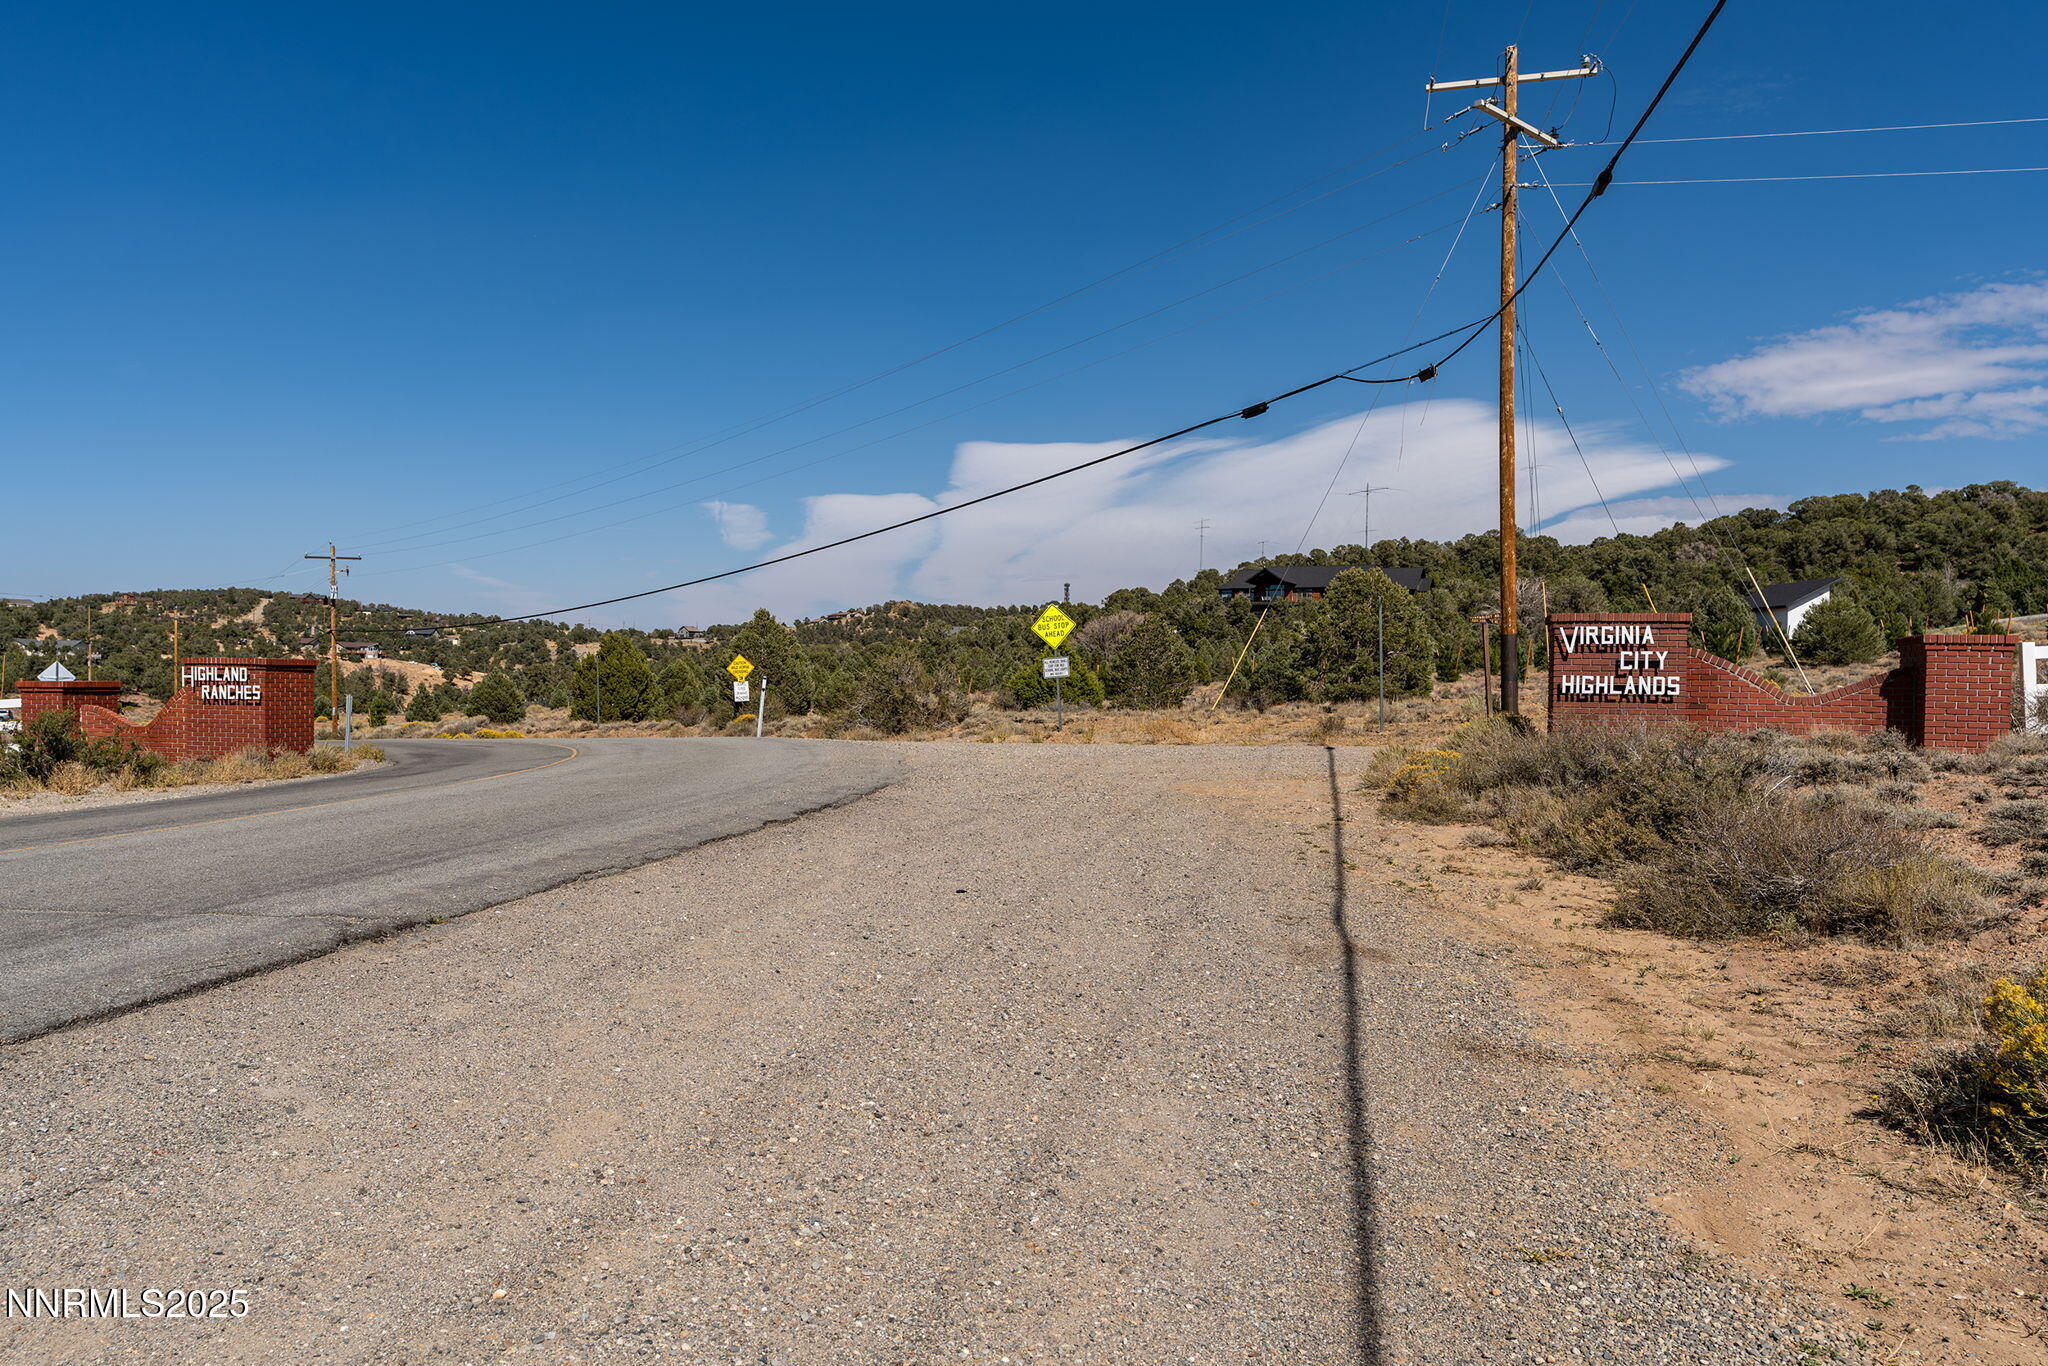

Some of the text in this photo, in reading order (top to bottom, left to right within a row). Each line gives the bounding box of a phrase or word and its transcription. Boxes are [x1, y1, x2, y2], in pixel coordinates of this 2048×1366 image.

[1038, 623, 1050, 631] BUS
[1042, 615, 1065, 623] SCHOOL
[1559, 625, 1655, 654] VIRGINIA
[1620, 650, 1668, 670] CITY
[181, 665, 249, 687] HIGHLAND
[1562, 674, 1681, 695] HIGHLANDS
[201, 685, 261, 700] RANCHES
